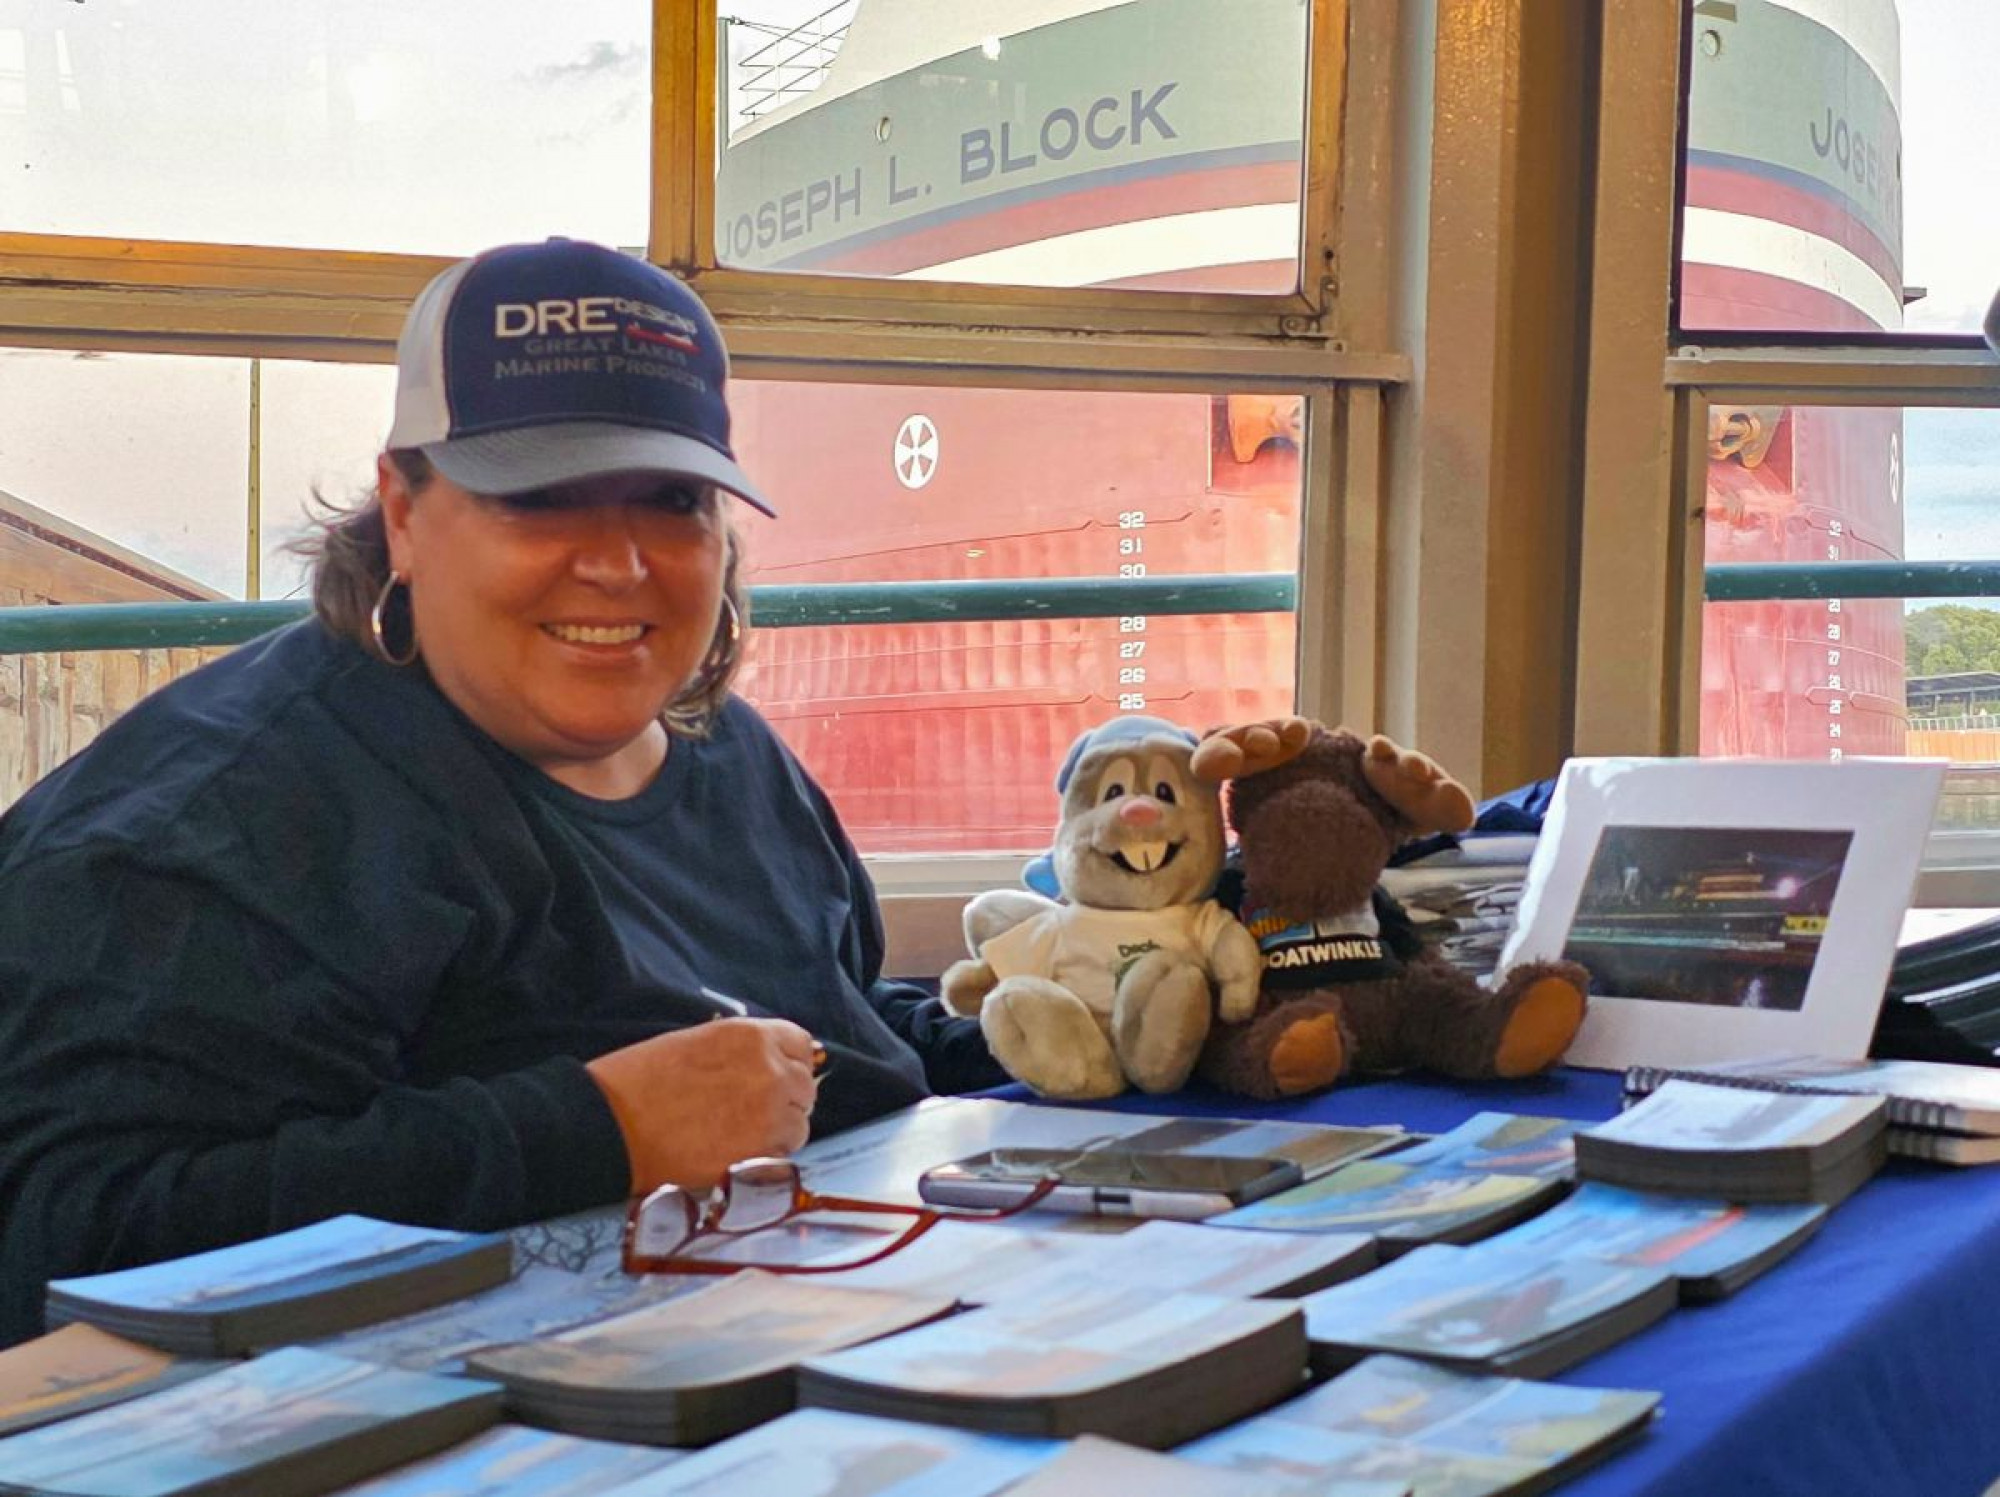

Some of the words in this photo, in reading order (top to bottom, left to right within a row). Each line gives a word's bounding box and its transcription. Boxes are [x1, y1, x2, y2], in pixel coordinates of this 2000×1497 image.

[720, 167, 861, 260] JOSEPH
[888, 156, 932, 205] L.
[960, 82, 1180, 185] BLOCK
[495, 297, 618, 338] DRE
[524, 336, 613, 355] GREAT
[495, 356, 599, 379] MARINE
[1119, 511, 1146, 529] 32
[1119, 537, 1142, 555] 31
[1119, 563, 1146, 578] 30
[1119, 617, 1146, 633] 28
[1119, 641, 1146, 659] 27
[1119, 667, 1146, 684] 26
[1119, 693, 1146, 710] 25
[1269, 939, 1383, 968] OATWINKLE
